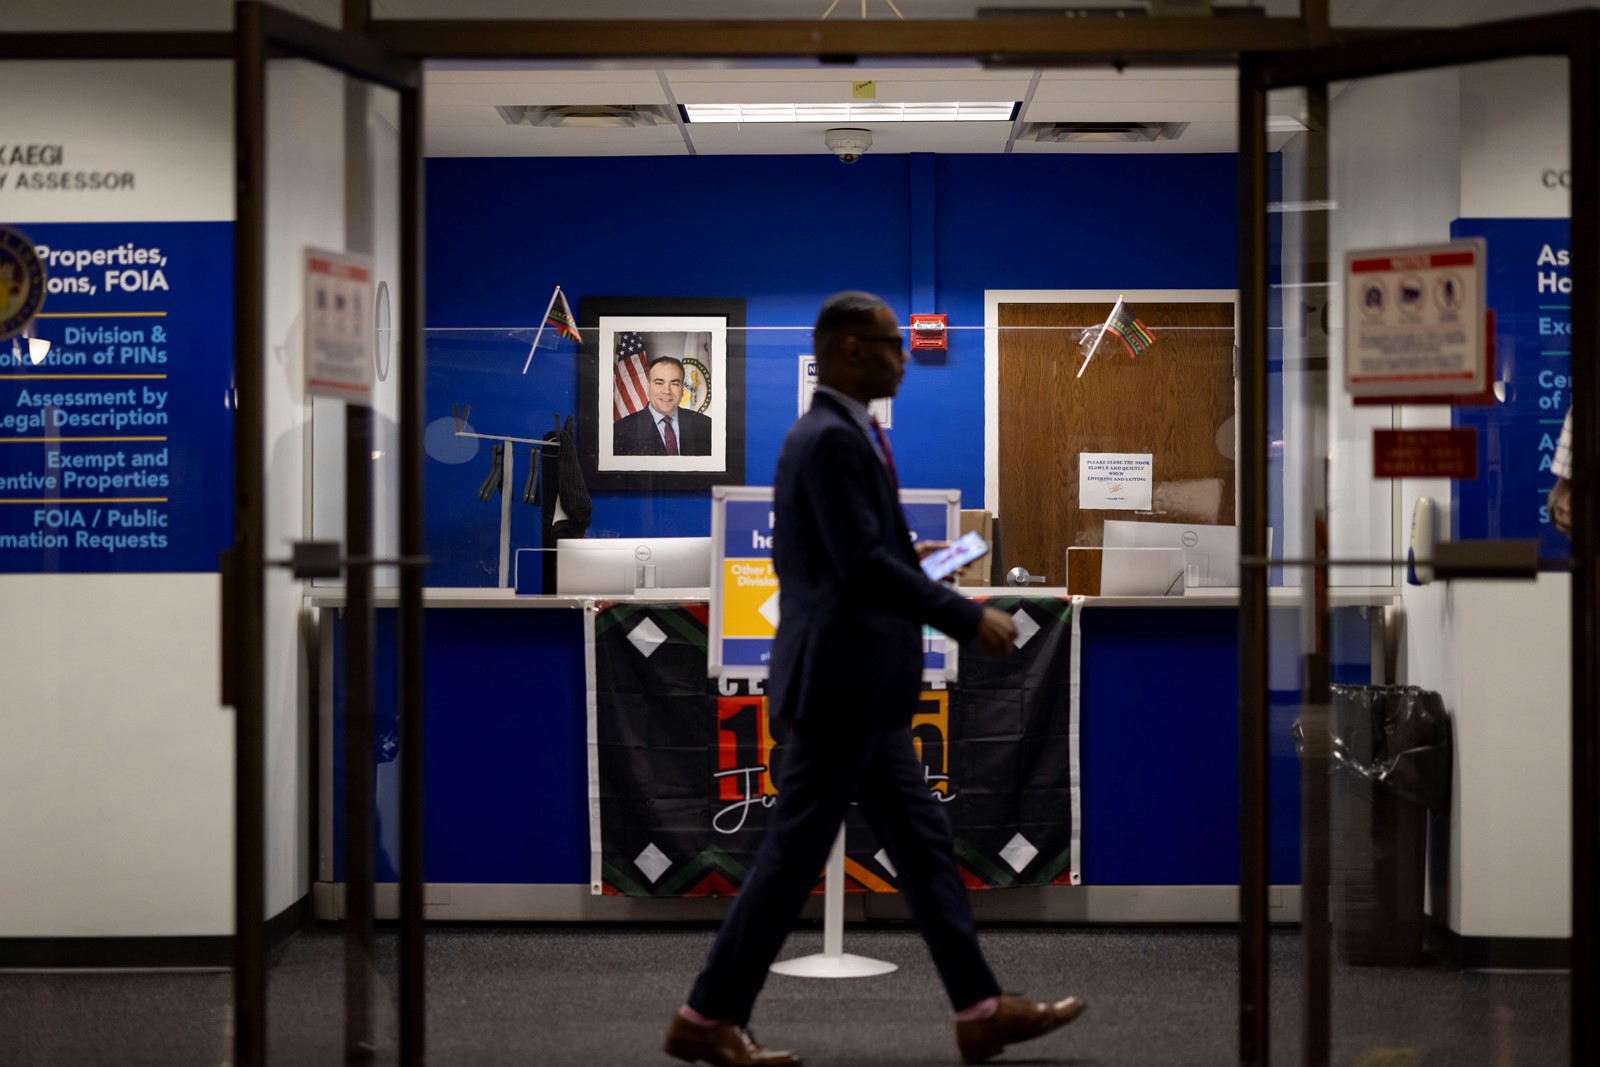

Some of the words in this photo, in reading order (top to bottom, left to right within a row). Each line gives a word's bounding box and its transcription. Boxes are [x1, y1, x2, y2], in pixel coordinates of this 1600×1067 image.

[16, 172, 135, 190] ASSESSOR
[34, 243, 167, 272] Properties,
[105, 269, 169, 292] FOIA
[65, 326, 144, 345] Division
[151, 325, 167, 343] &
[93, 346, 114, 365] of
[121, 346, 167, 364] PINs
[17, 388, 136, 407] Assessment
[143, 386, 168, 409] by
[1539, 391, 1561, 409] of
[0, 409, 45, 433] egal
[53, 408, 168, 430] Description
[48, 451, 125, 472] Exempt
[131, 448, 168, 467] and
[64, 469, 169, 493] Properties
[34, 509, 86, 528] FOIA
[92, 509, 101, 528] /
[107, 508, 168, 527] Public
[76, 530, 168, 552] Requests
[732, 564, 764, 575] Other
